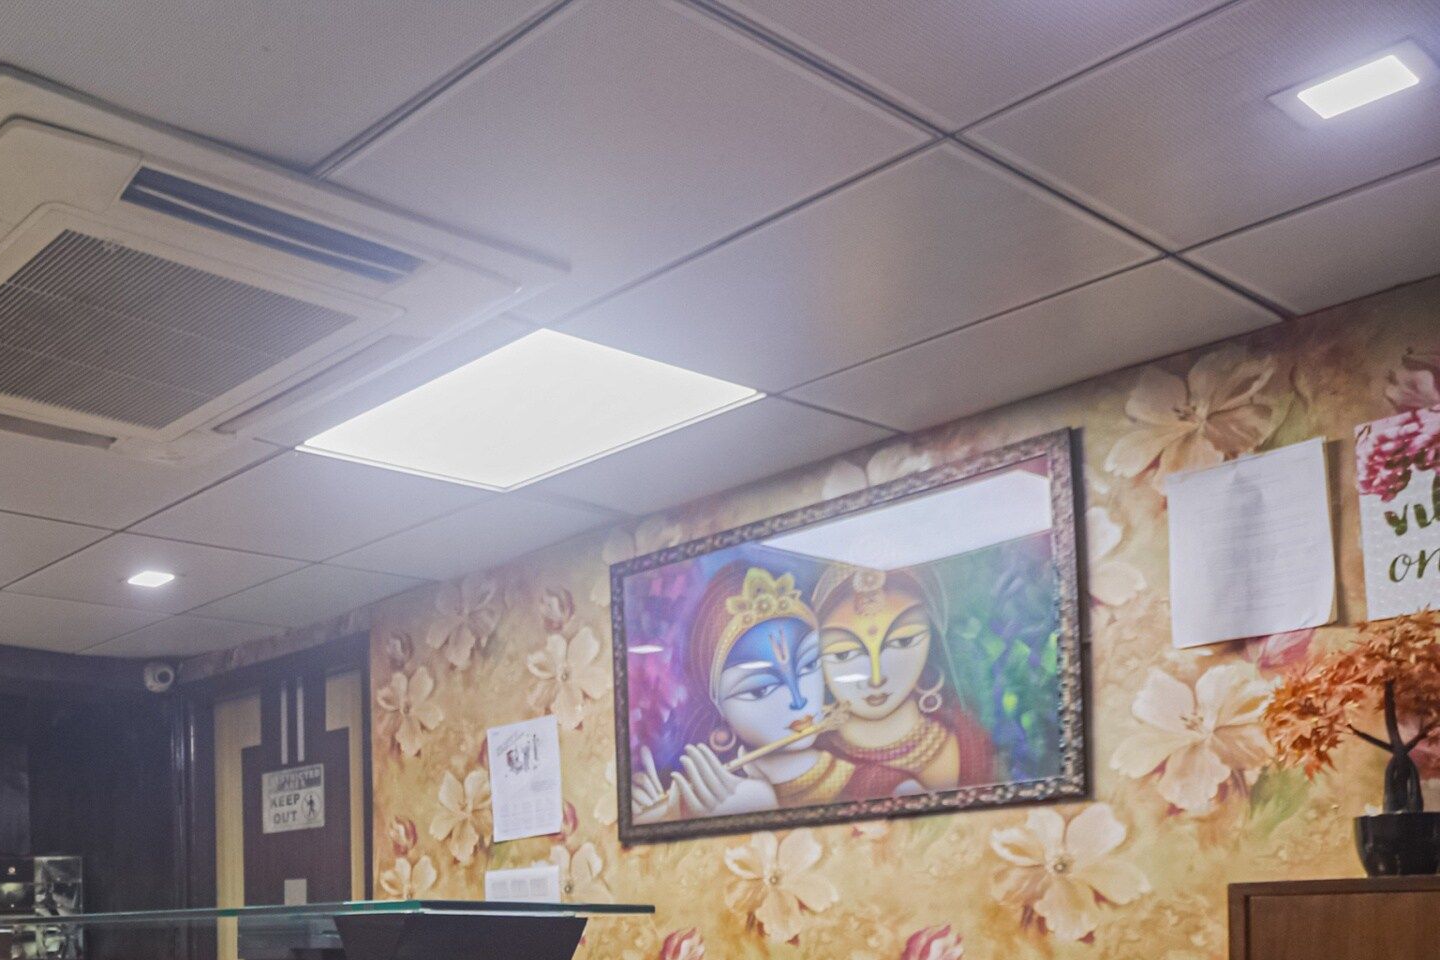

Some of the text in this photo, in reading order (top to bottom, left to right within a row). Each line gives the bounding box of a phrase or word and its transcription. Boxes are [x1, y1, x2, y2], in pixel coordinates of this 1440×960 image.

[1384, 475, 1440, 536] vi
[271, 793, 300, 808] KEEP
[273, 810, 297, 824] OUT
